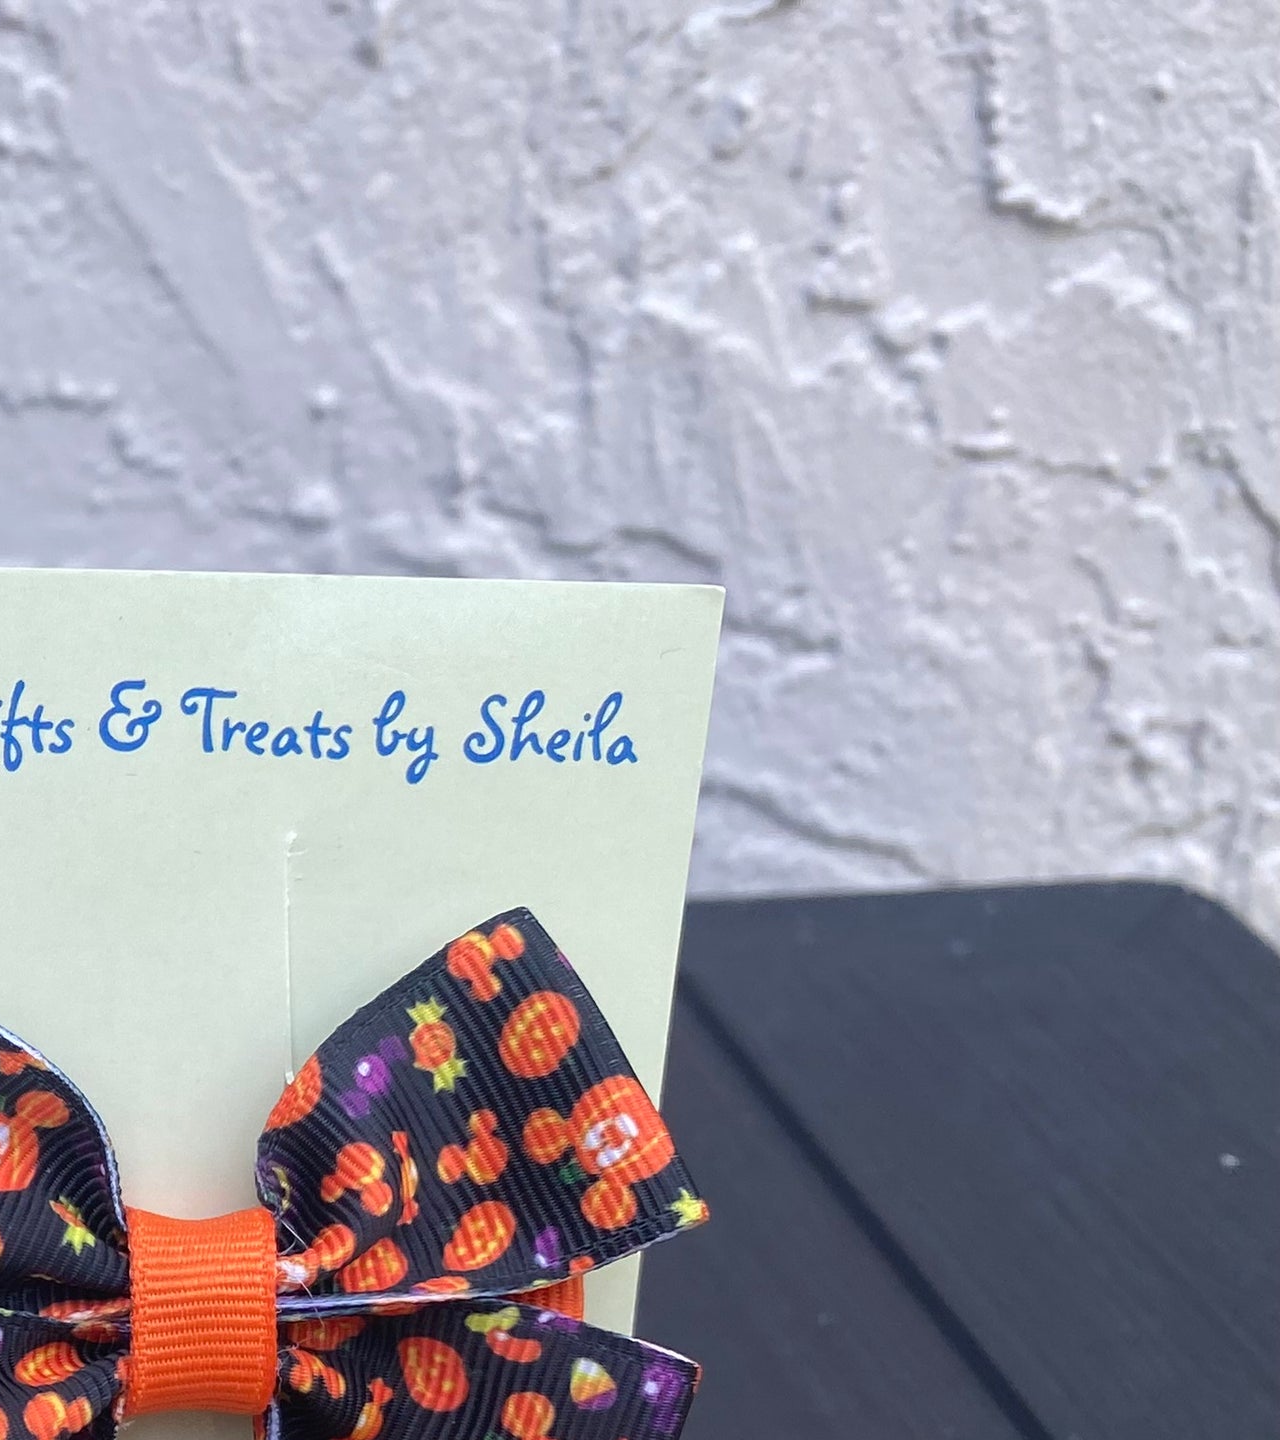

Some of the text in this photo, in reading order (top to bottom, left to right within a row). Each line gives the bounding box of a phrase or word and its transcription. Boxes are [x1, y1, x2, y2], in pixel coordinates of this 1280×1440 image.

[97, 679, 165, 754] &
[179, 686, 355, 762] Treats
[372, 689, 441, 786] by
[462, 688, 640, 767] Sheila
